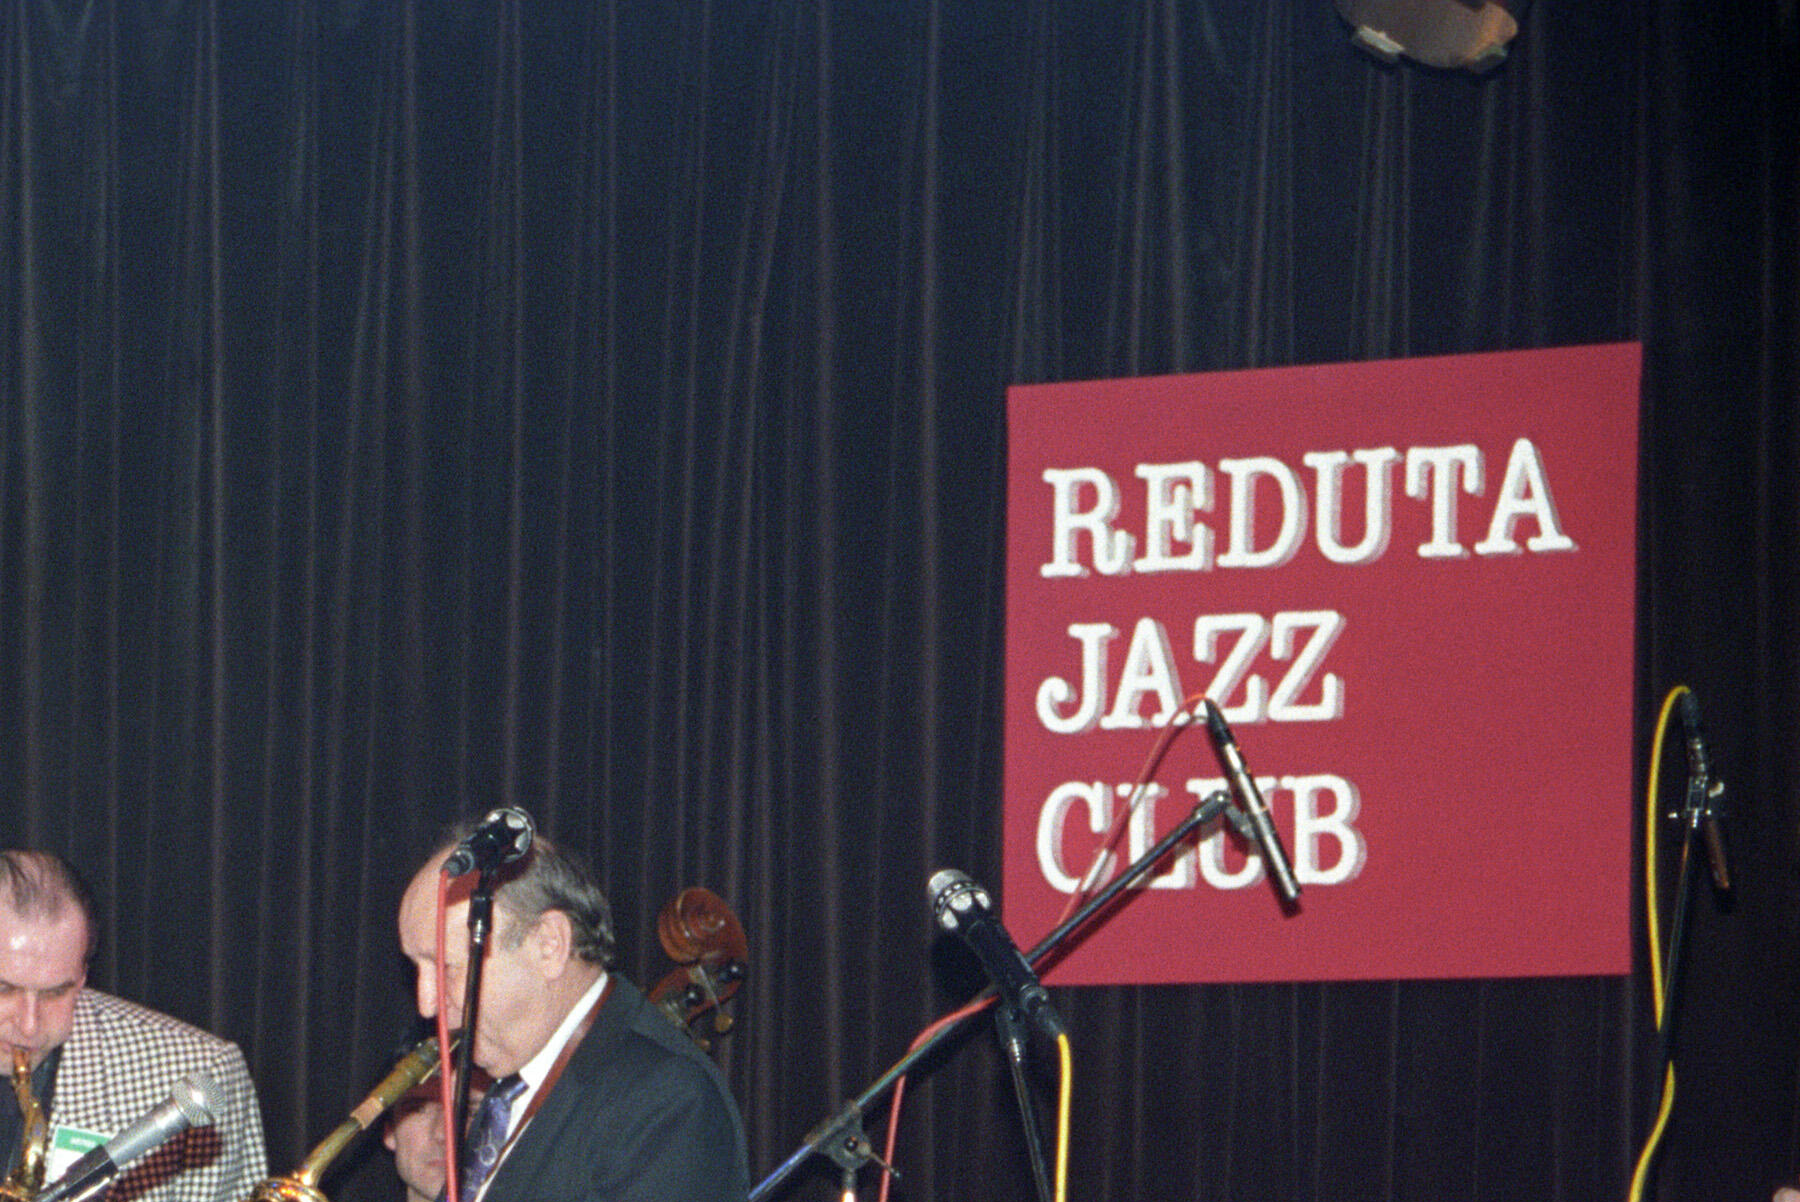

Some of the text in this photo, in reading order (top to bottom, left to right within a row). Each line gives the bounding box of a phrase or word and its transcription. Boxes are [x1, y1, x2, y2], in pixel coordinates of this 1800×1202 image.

[1040, 437, 1579, 577] REDUTA
[1036, 610, 1346, 733] JAZZ
[1036, 774, 1367, 894] CLUB
